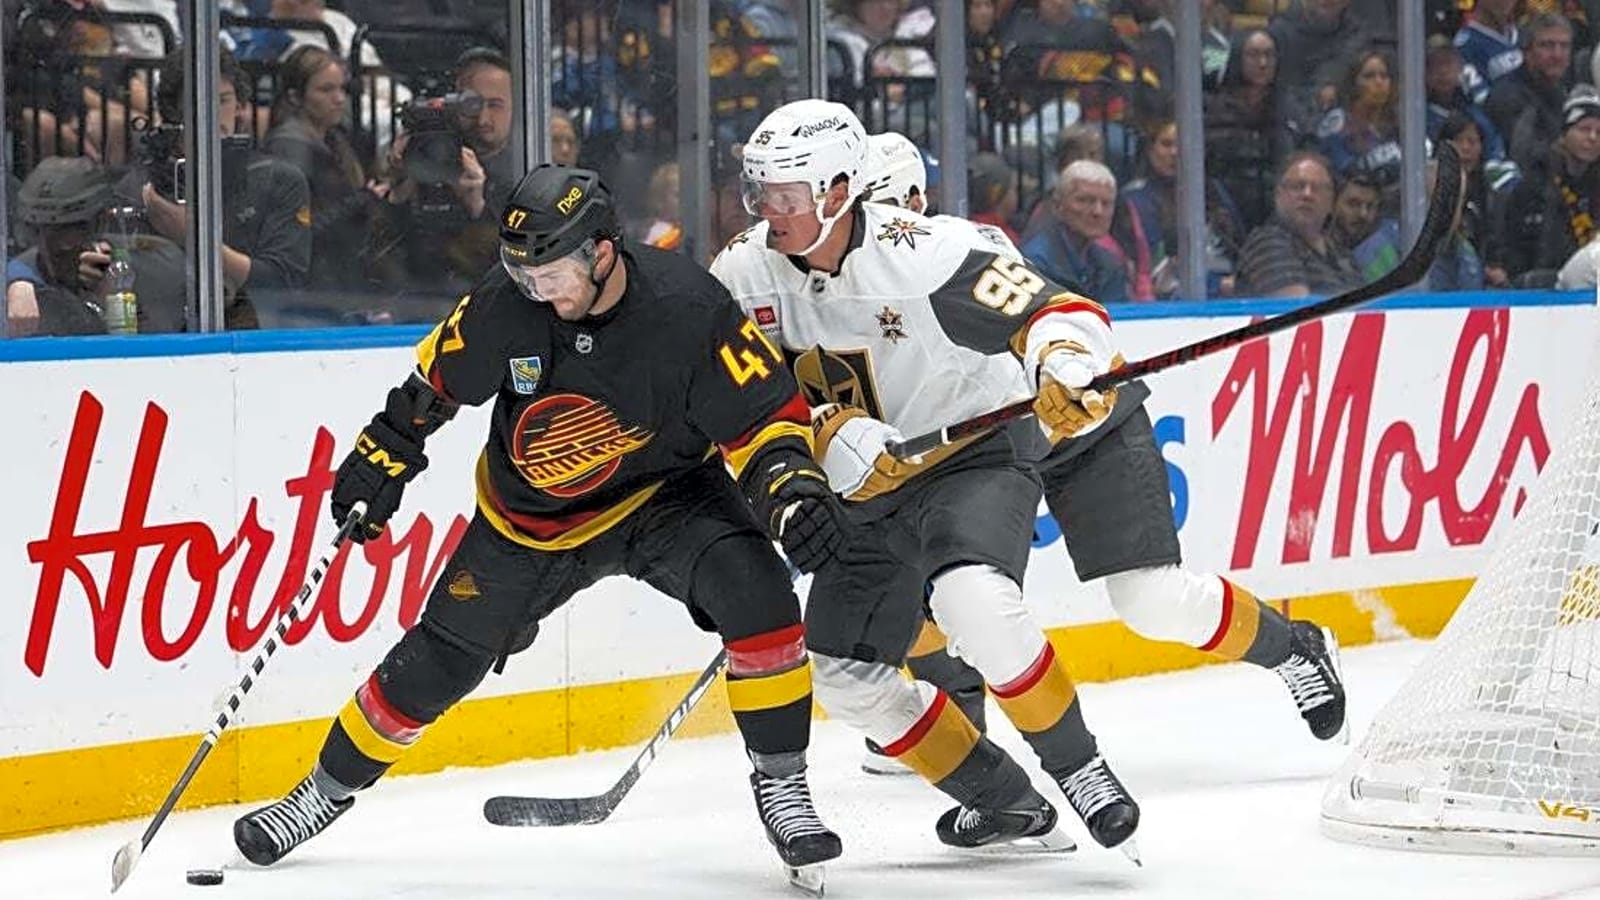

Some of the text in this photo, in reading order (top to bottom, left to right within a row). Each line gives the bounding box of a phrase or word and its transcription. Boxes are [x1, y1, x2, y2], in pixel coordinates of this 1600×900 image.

[507, 209, 526, 230] 47
[972, 255, 1046, 316] 95
[719, 318, 783, 386] 47
